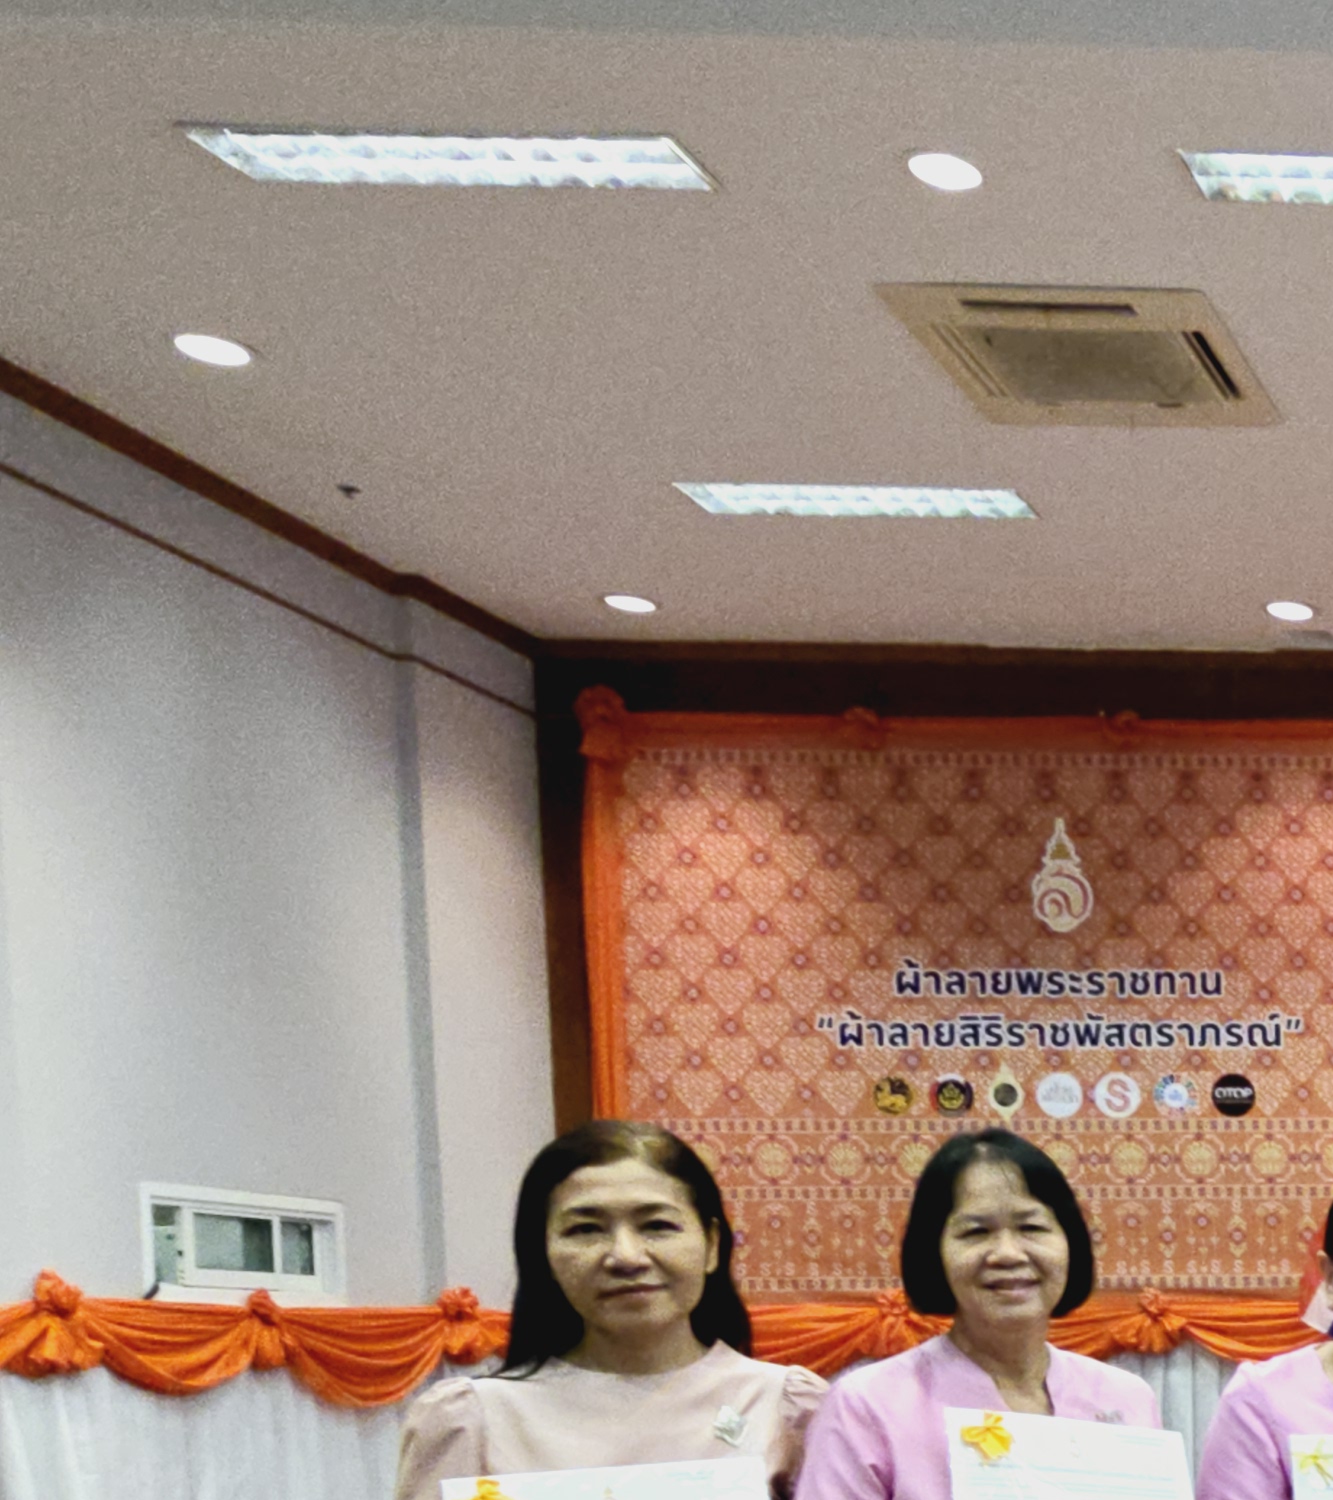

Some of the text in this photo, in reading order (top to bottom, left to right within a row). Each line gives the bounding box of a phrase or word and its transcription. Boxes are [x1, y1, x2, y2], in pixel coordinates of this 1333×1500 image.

[896, 958, 1222, 996] ผ้าลายพระราชทาน
[1213, 1086, 1253, 1099] OTOP
